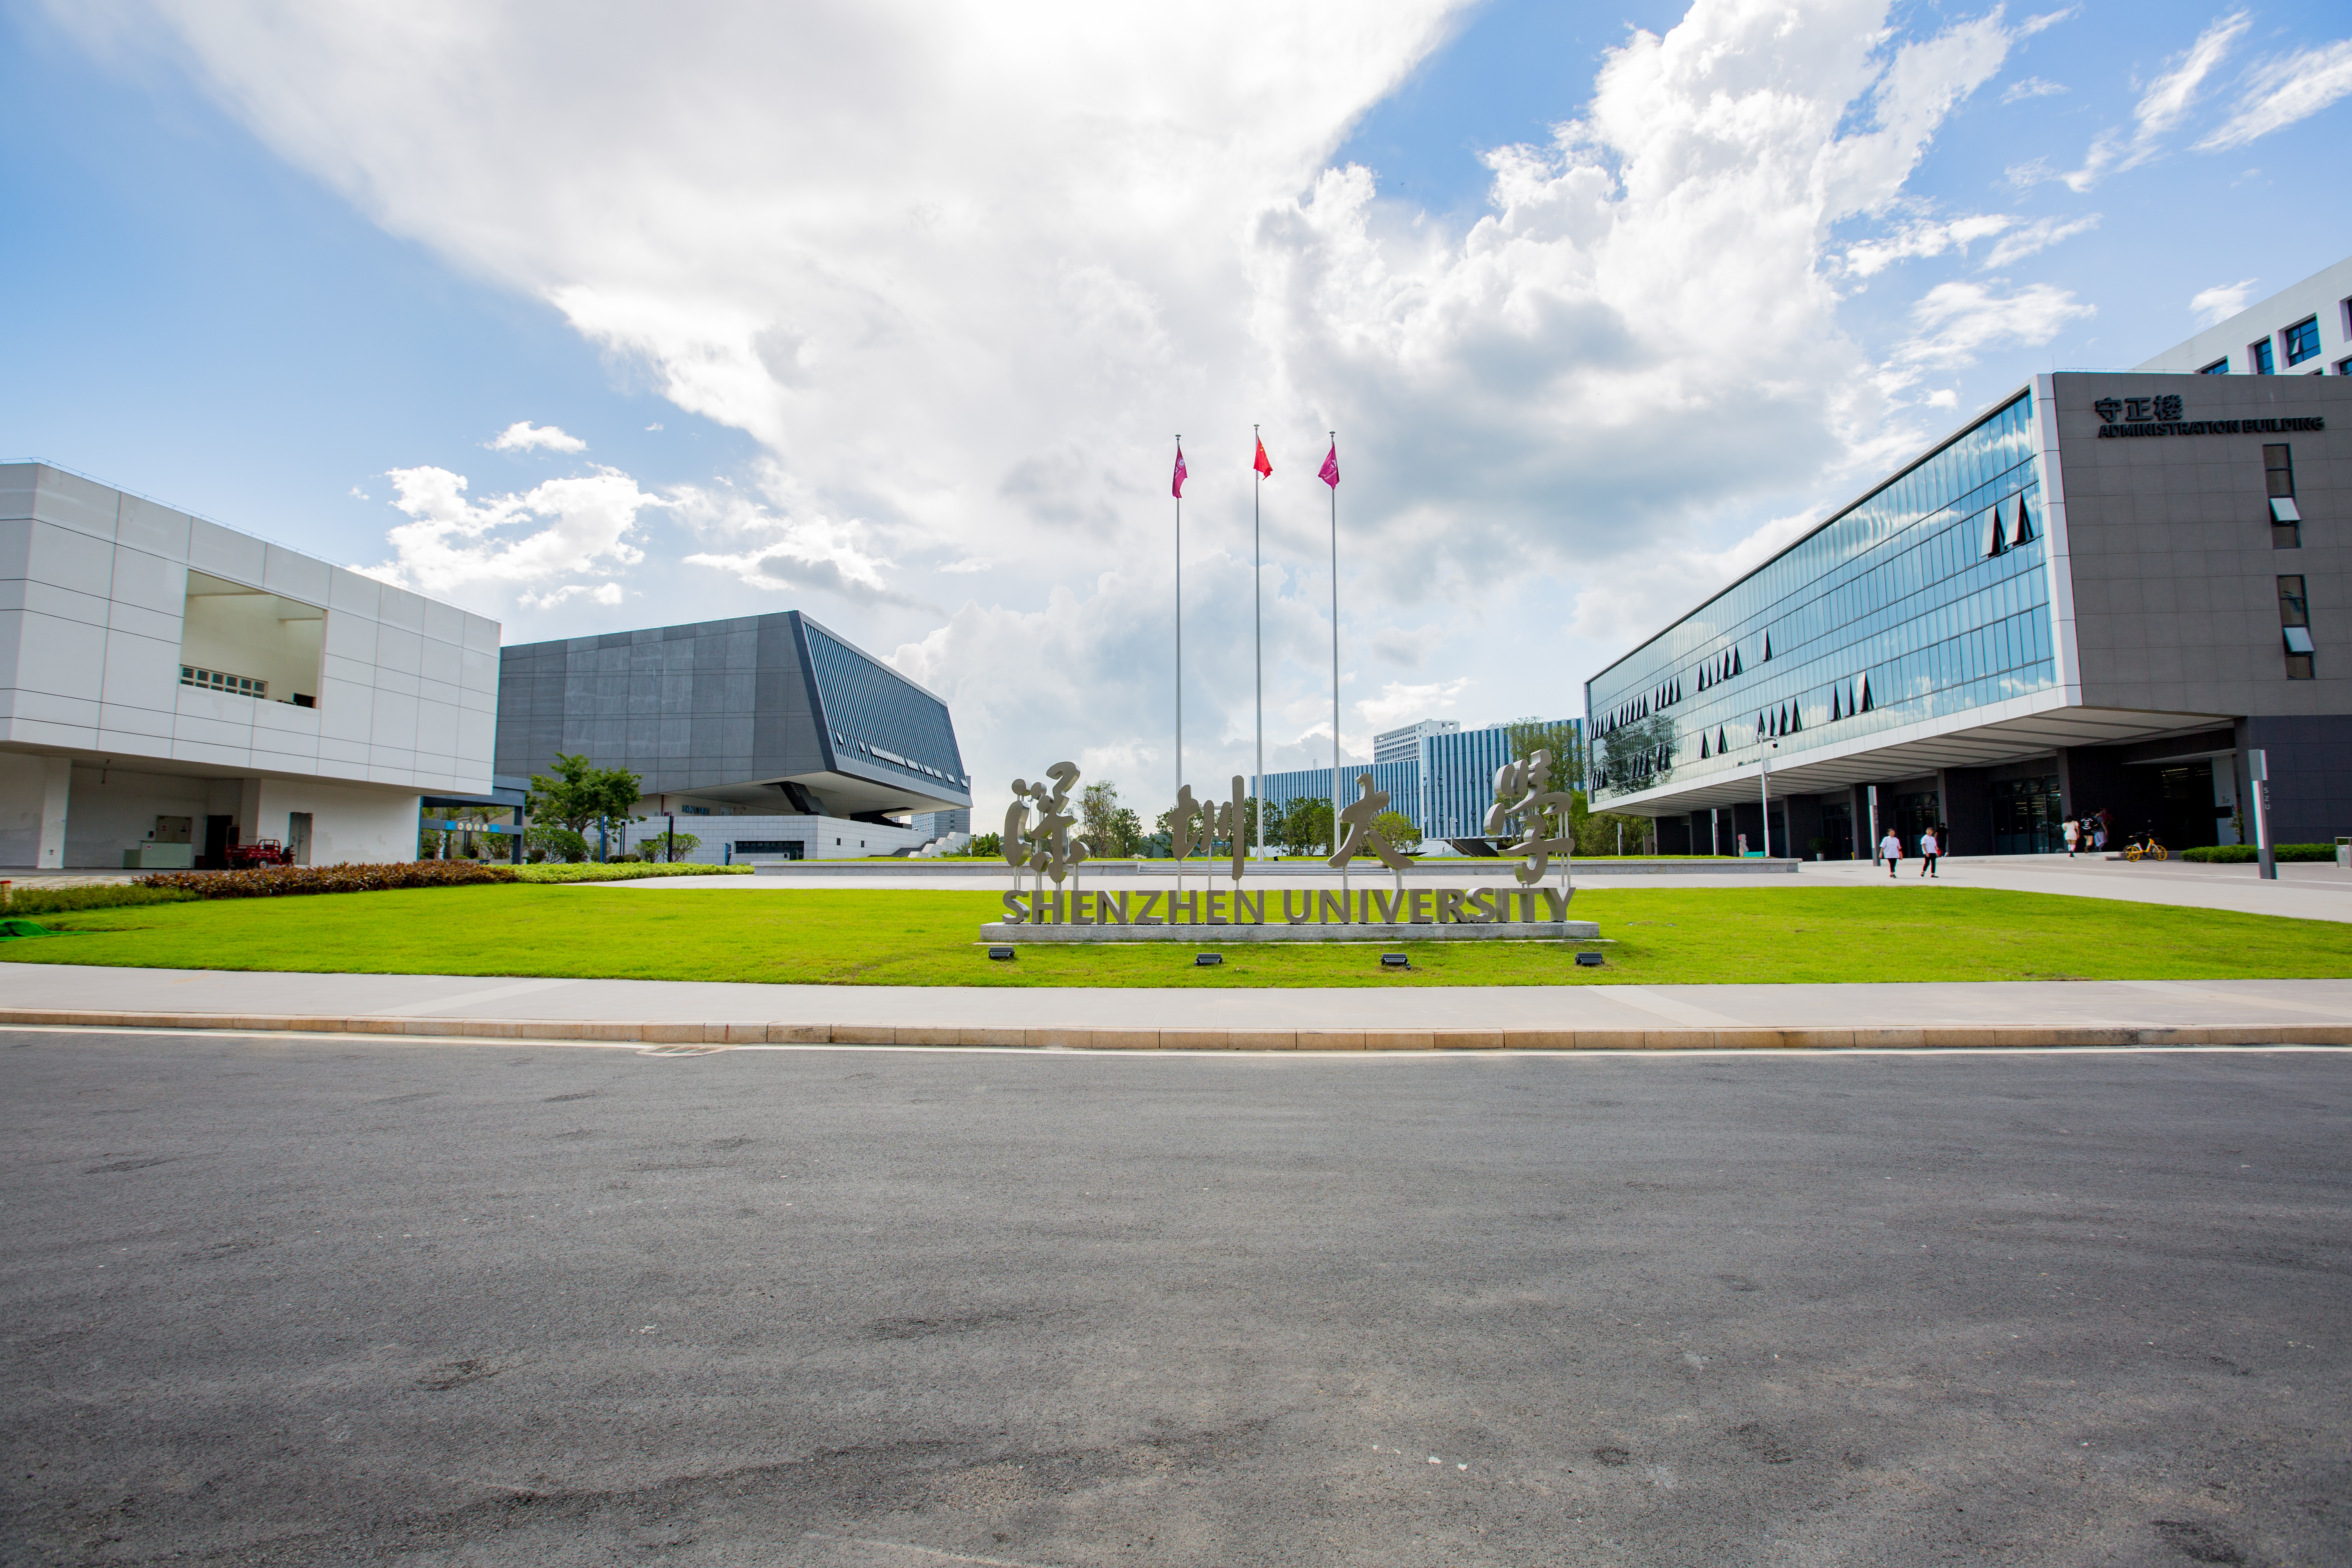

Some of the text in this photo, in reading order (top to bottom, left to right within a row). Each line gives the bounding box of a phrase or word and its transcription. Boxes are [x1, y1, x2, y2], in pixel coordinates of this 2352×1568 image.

[2095, 394, 2183, 422] 守正楼
[2098, 416, 2325, 438] ADMINISTRATION BUILDING
[1002, 887, 1576, 924] SHENZHEN UNIVERSITY
